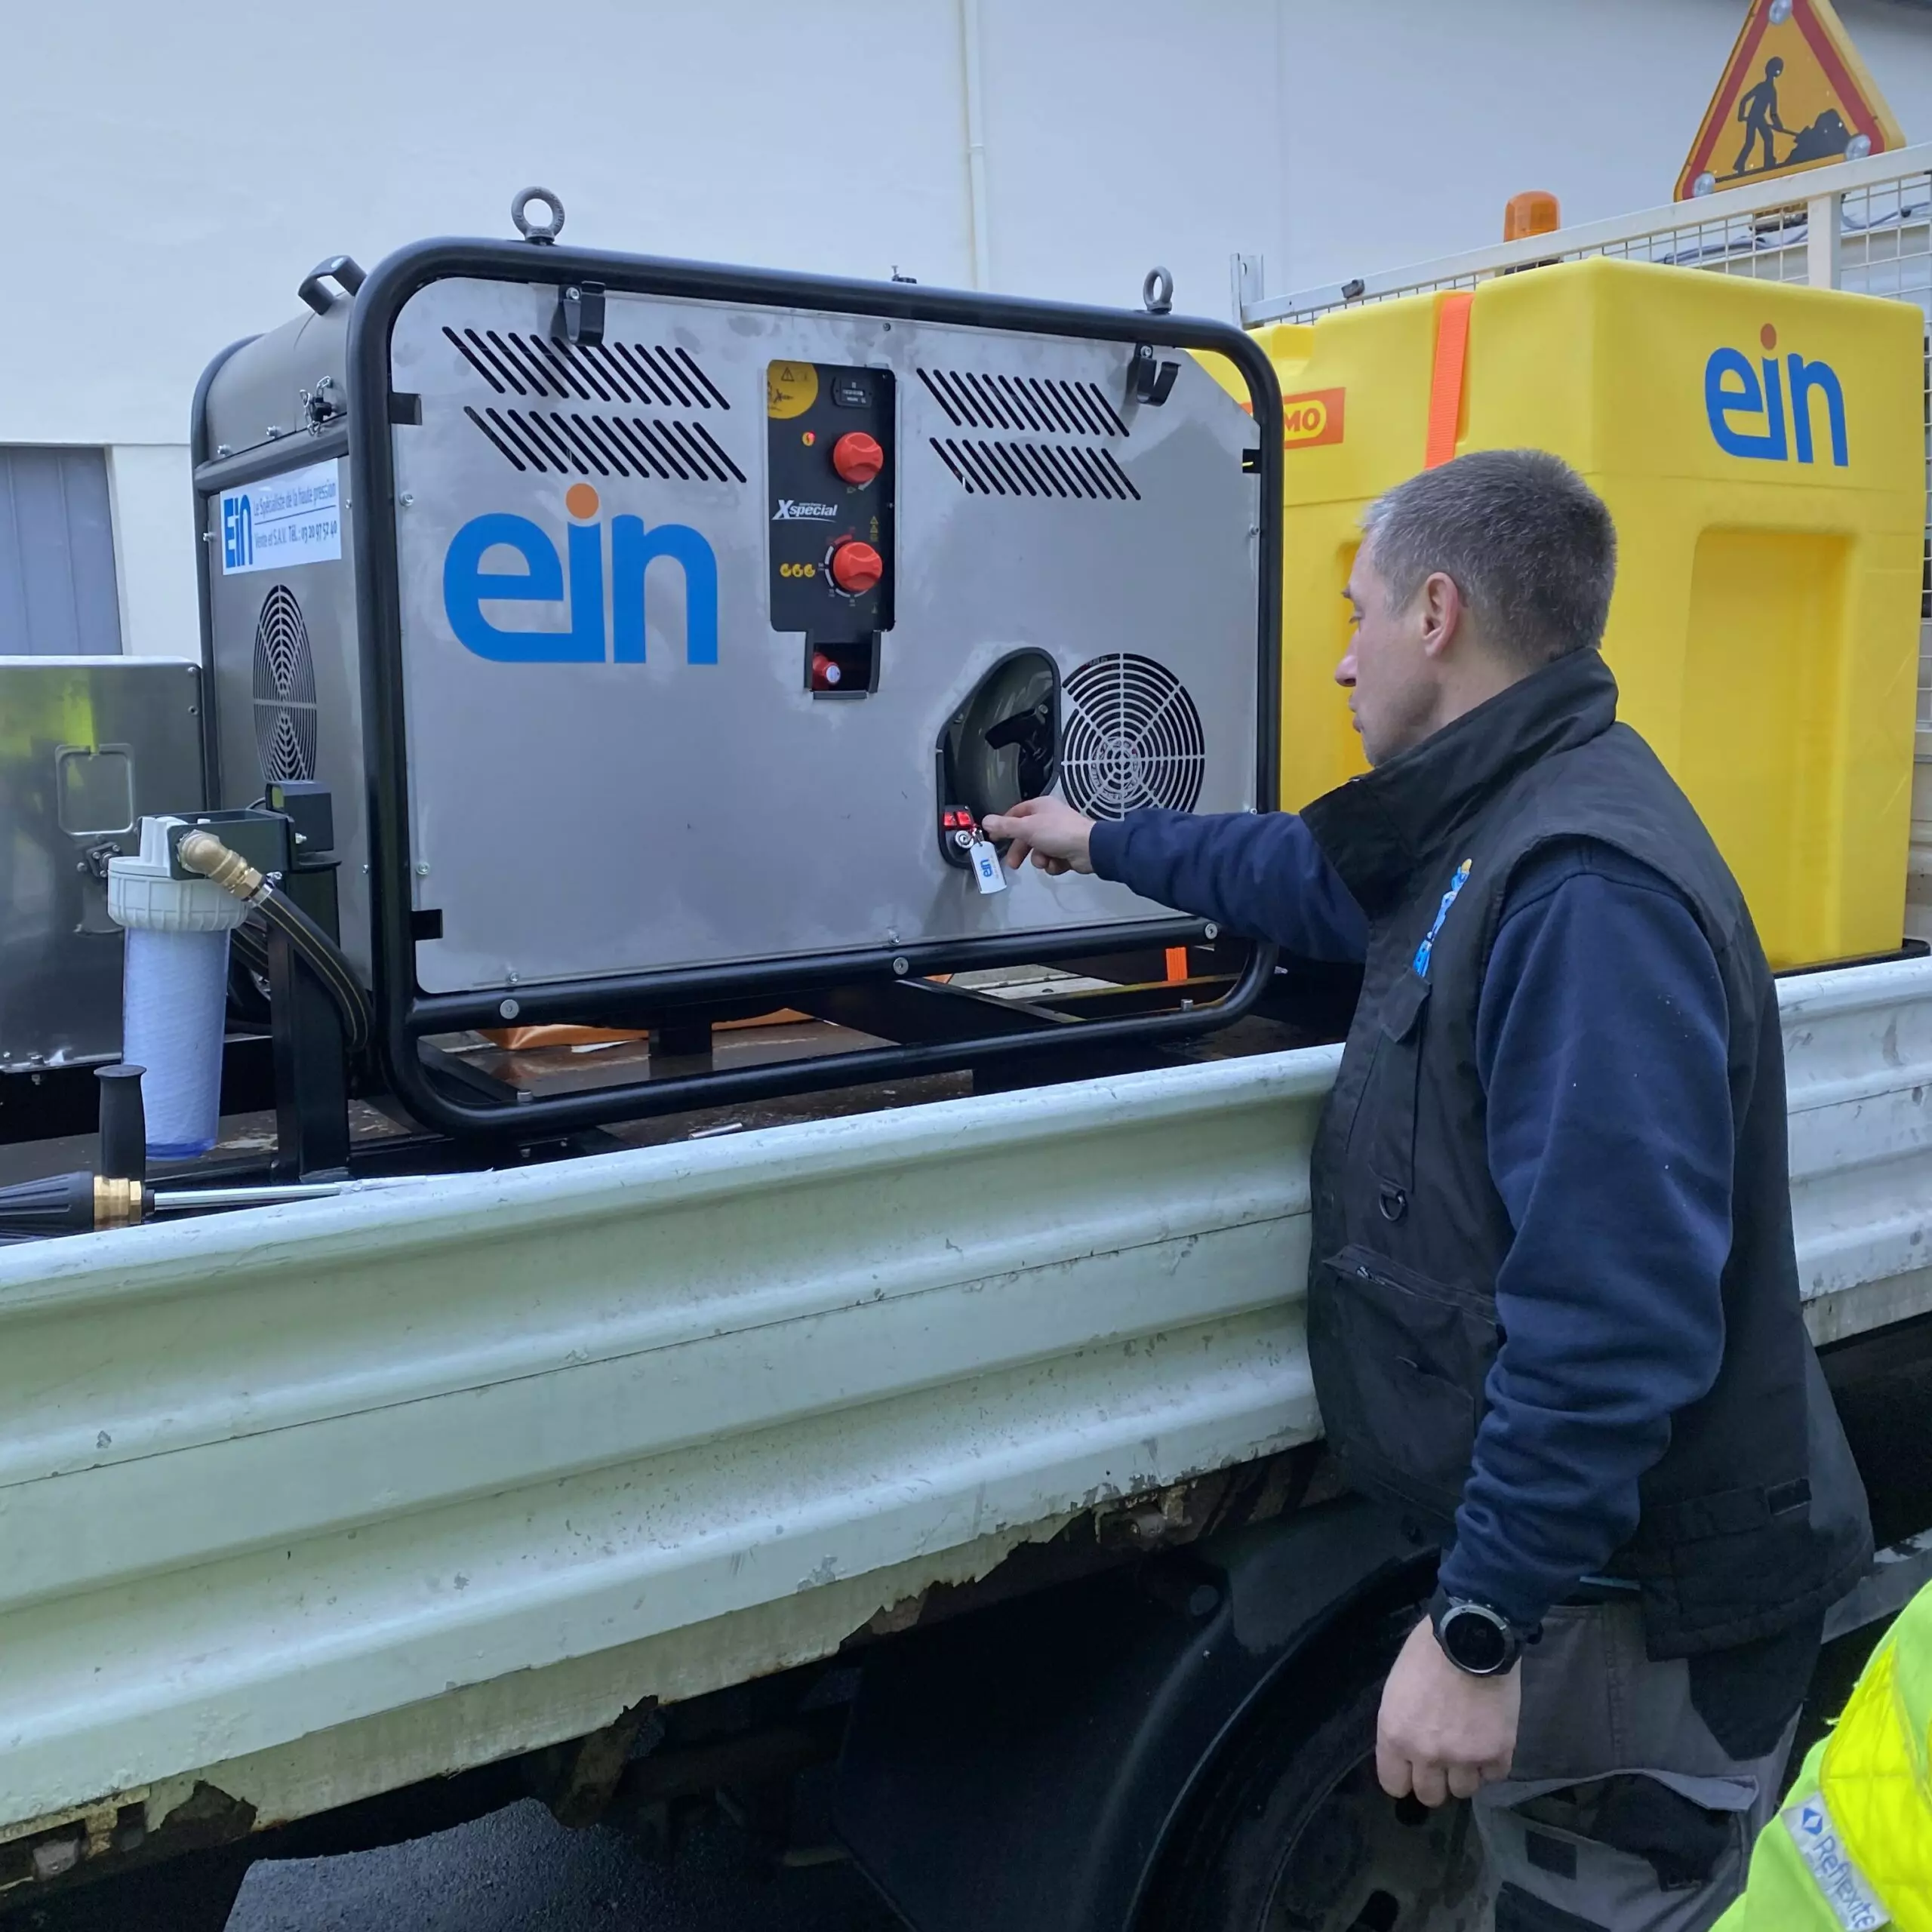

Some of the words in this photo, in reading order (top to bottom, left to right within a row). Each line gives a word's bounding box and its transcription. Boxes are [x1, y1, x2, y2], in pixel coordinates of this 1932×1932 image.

[1704, 323, 1849, 467] ein
[1284, 408, 1321, 432] MO
[286, 491, 292, 508] de
[293, 488, 297, 506] la
[298, 486, 312, 504] haute
[313, 479, 336, 506] pression
[301, 526, 307, 543] 03
[443, 483, 718, 666] ein
[980, 859, 992, 877] ein
[1813, 1835, 1875, 1929] Reflexite
